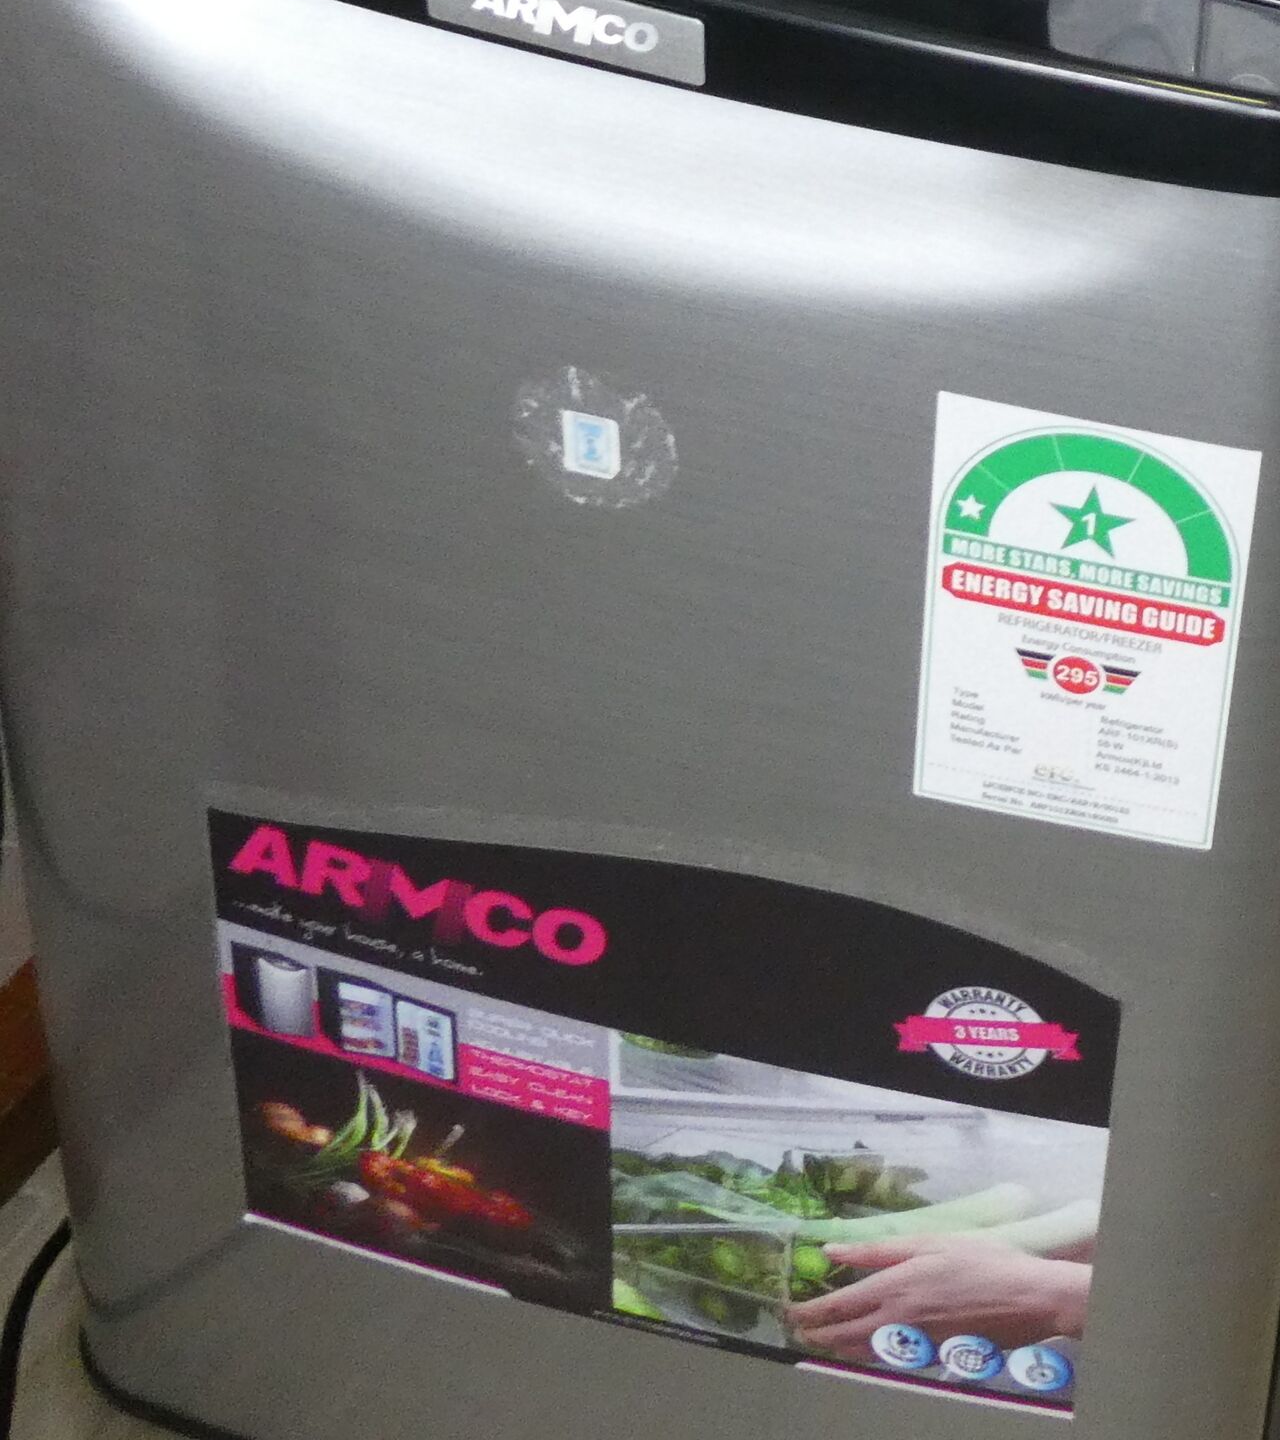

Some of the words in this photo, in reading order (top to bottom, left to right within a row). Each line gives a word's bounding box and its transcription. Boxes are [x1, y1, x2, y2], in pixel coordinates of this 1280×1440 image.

[1081, 513, 1096, 535] 1
[951, 538, 1007, 562] MORE
[1079, 564, 1134, 588] MORE
[1136, 577, 1223, 605] SAVINGS
[951, 569, 1045, 606] ENERGY
[1047, 588, 1137, 625] SAVING
[1141, 607, 1217, 639] GUIDE
[998, 612, 1162, 654] REFRIGERATOR/FREEZER
[1021, 634, 1059, 651] Energy
[1061, 643, 1136, 664] Consumption
[1055, 665, 1099, 686] 295
[227, 822, 609, 966] ARMCO
[937, 989, 1029, 1012] WARRANTY
[954, 1025, 966, 1039] 3
[968, 1026, 1020, 1042] YEARS
[950, 1051, 1035, 1077] WARRANTY
